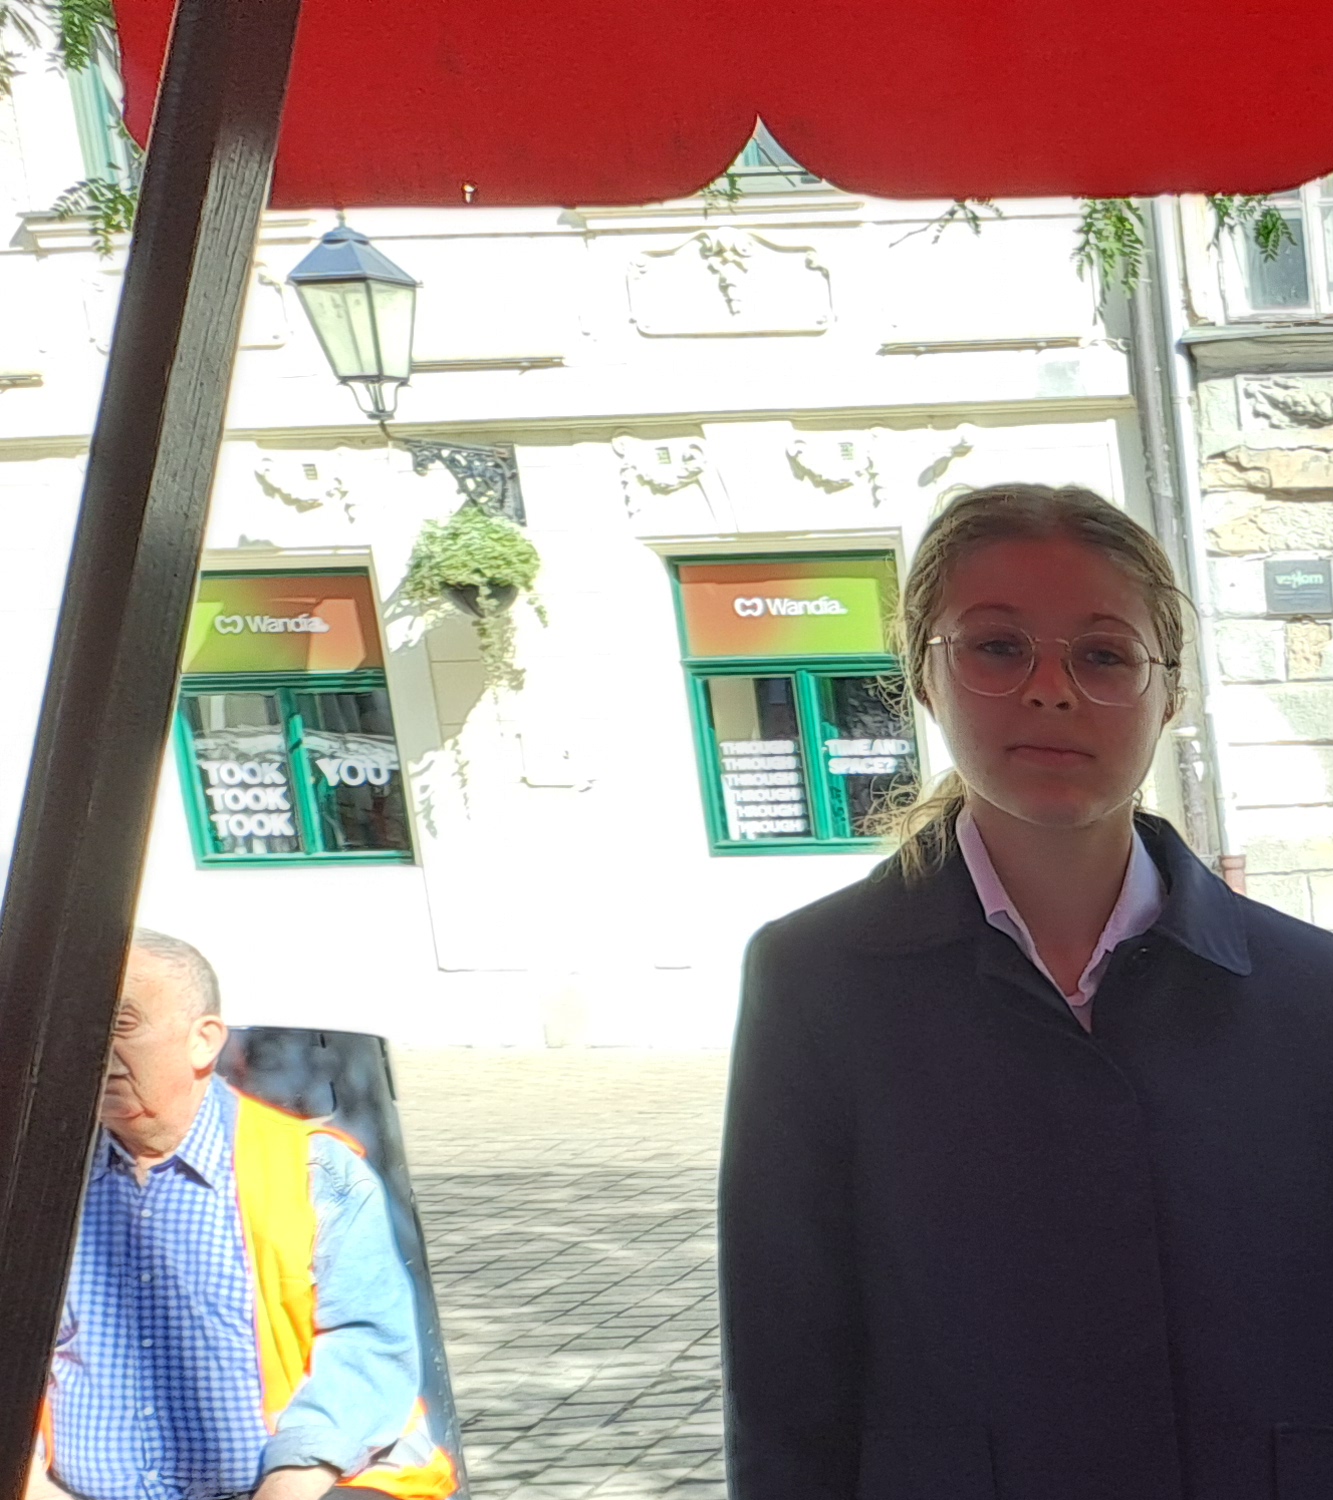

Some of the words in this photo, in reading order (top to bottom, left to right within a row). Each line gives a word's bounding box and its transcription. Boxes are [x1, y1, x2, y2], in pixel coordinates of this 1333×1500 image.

[872, 739, 910, 755] AND
[202, 760, 287, 785] TOOK
[316, 758, 392, 787] YOU
[206, 786, 290, 810] TOOK
[210, 812, 295, 836] TOOK
